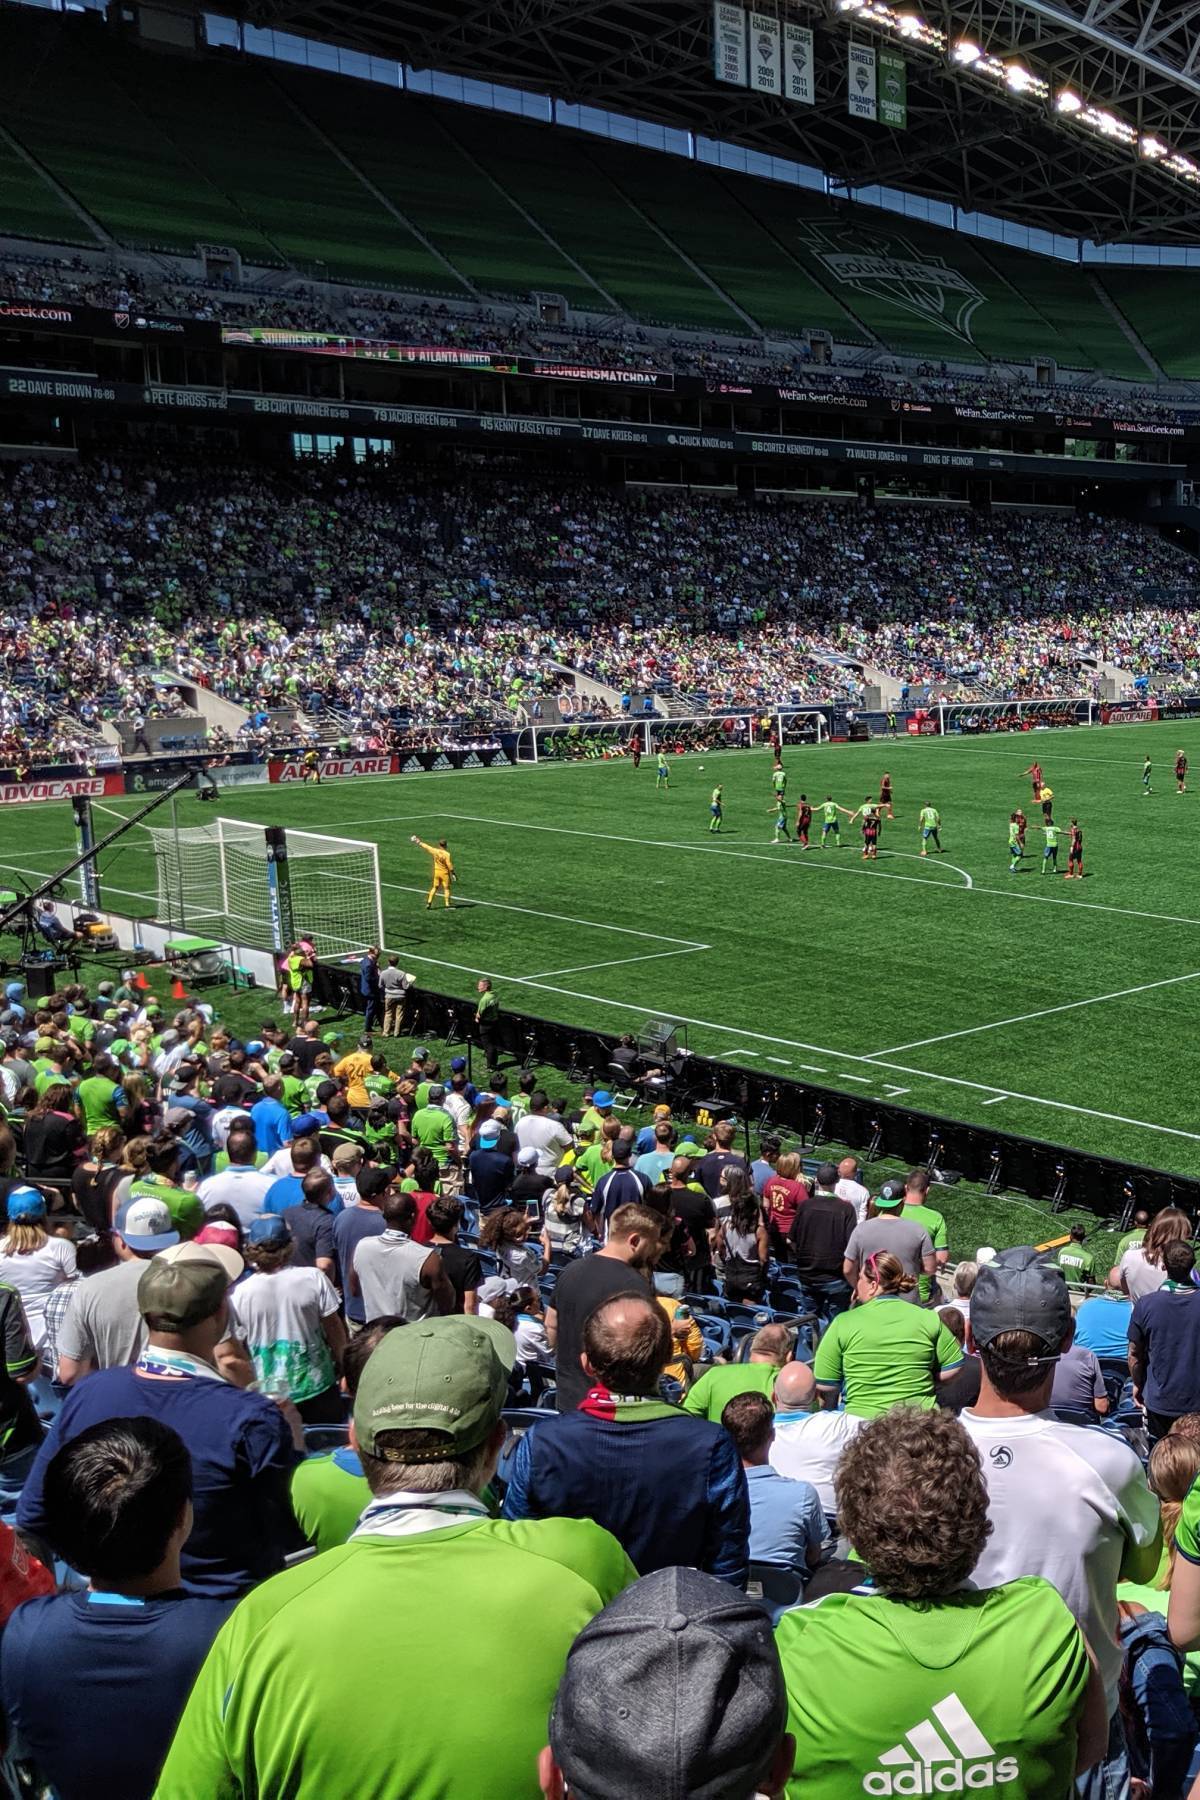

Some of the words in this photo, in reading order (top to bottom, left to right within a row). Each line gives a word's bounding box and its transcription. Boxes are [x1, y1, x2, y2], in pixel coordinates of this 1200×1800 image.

[752, 21, 778, 36] CHAMPS
[786, 32, 811, 46] CHAMPS
[850, 52, 874, 66] SHIELD
[758, 65, 774, 78] 2009
[758, 76, 774, 88] 2010
[792, 75, 807, 86] 2011
[792, 86, 808, 97] 2014
[850, 94, 876, 107] CHAMPS
[855, 104, 870, 114] 2014
[418, 351, 459, 364] ATLANTA
[460, 354, 491, 366] UNITED
[8, 378, 28, 393] 22
[28, 380, 54, 396] DAVE
[55, 382, 93, 399] BROWN
[152, 390, 175, 404] PETE
[176, 392, 207, 407] GROSS
[778, 388, 868, 408] WeFan.SeatGeek.com
[254, 400, 270, 412] 28
[270, 402, 292, 414] CURT
[293, 403, 330, 418] WARNER
[954, 406, 1034, 422] WeFan.SeatGeek.com
[373, 409, 388, 421] 79
[388, 411, 414, 424] JACOB
[414, 413, 440, 426] GREEN
[480, 417, 494, 430] 45
[494, 419, 518, 432] KENNY
[519, 421, 544, 434] EASLEY
[1112, 422, 1184, 436] WeFan.SeatGeek.com
[593, 428, 610, 440] DAVE
[611, 430, 633, 442] KRIEG
[680, 436, 701, 448] CHUCK
[702, 438, 720, 448] KNOX
[751, 440, 763, 452] 96
[763, 442, 786, 454] CORTEZ
[786, 444, 815, 456] KENNEDY
[846, 448, 855, 459] 71
[855, 448, 878, 460] WALTER
[878, 450, 895, 461] JONES
[923, 454, 939, 465] RING
[941, 454, 950, 465] OF
[950, 454, 974, 466] HONOR
[1108, 710, 1152, 724] ADVOCARE
[0, 778, 105, 801] DVOCARE
[270, 887, 282, 951] SEATTLE
[772, 1191, 784, 1212] 10
[415, 1402, 427, 1410] the
[428, 1403, 450, 1412] digital
[862, 1756, 1020, 1796] adidas
